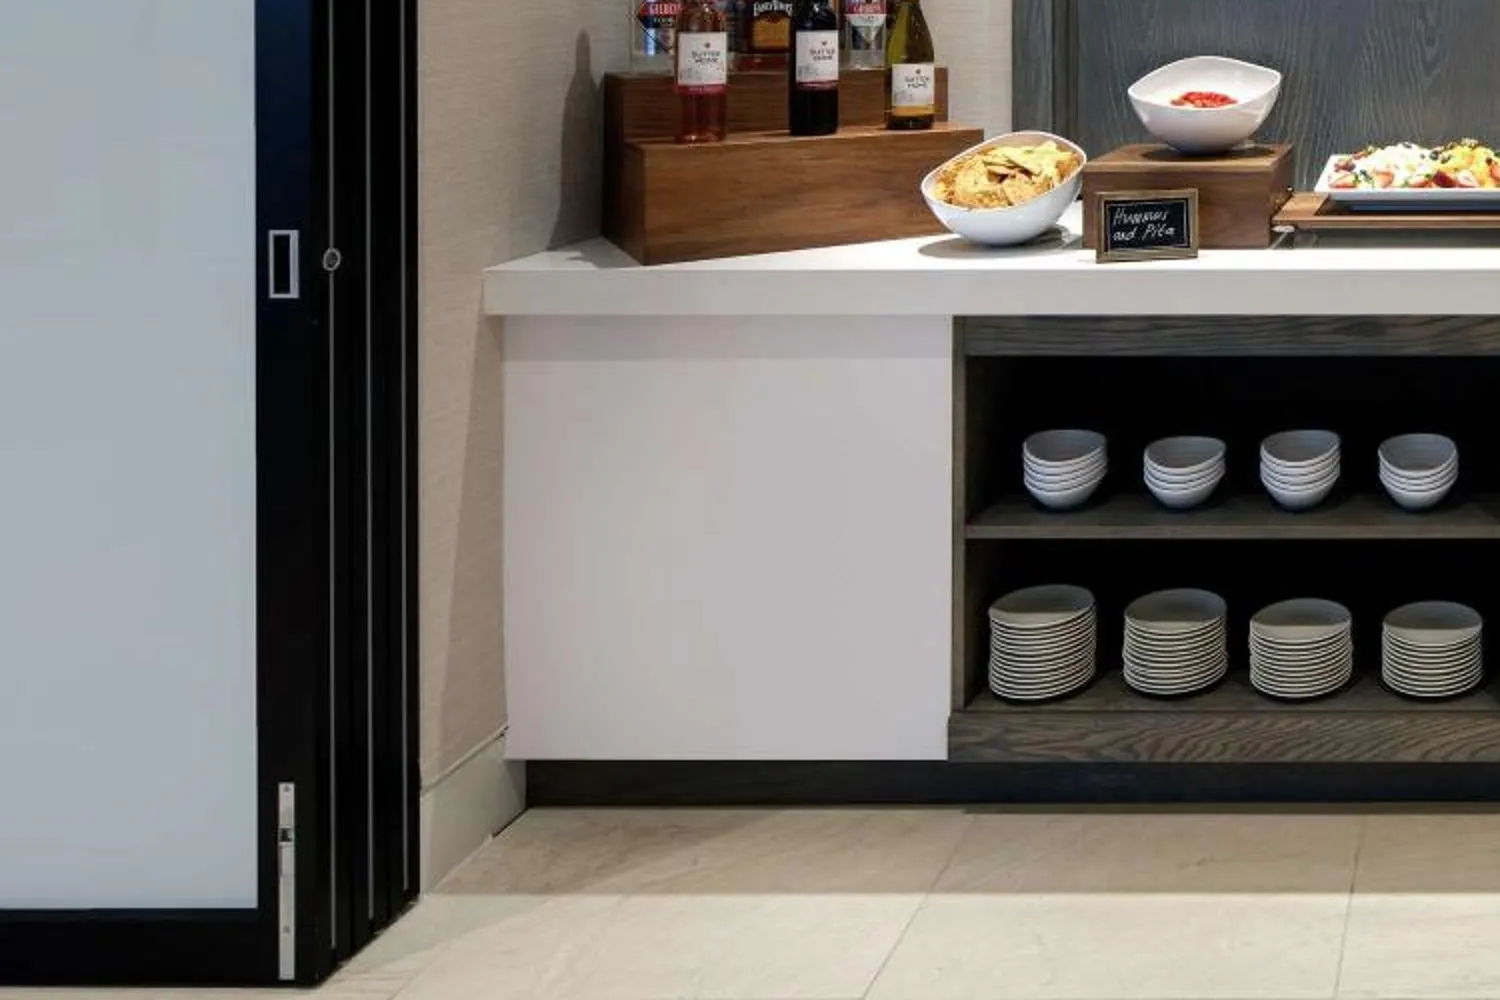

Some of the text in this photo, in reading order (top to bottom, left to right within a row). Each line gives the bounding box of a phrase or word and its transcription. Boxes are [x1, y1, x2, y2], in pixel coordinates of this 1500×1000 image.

[1112, 207, 1169, 225] Hummus
[1112, 222, 1176, 241] and Pita
